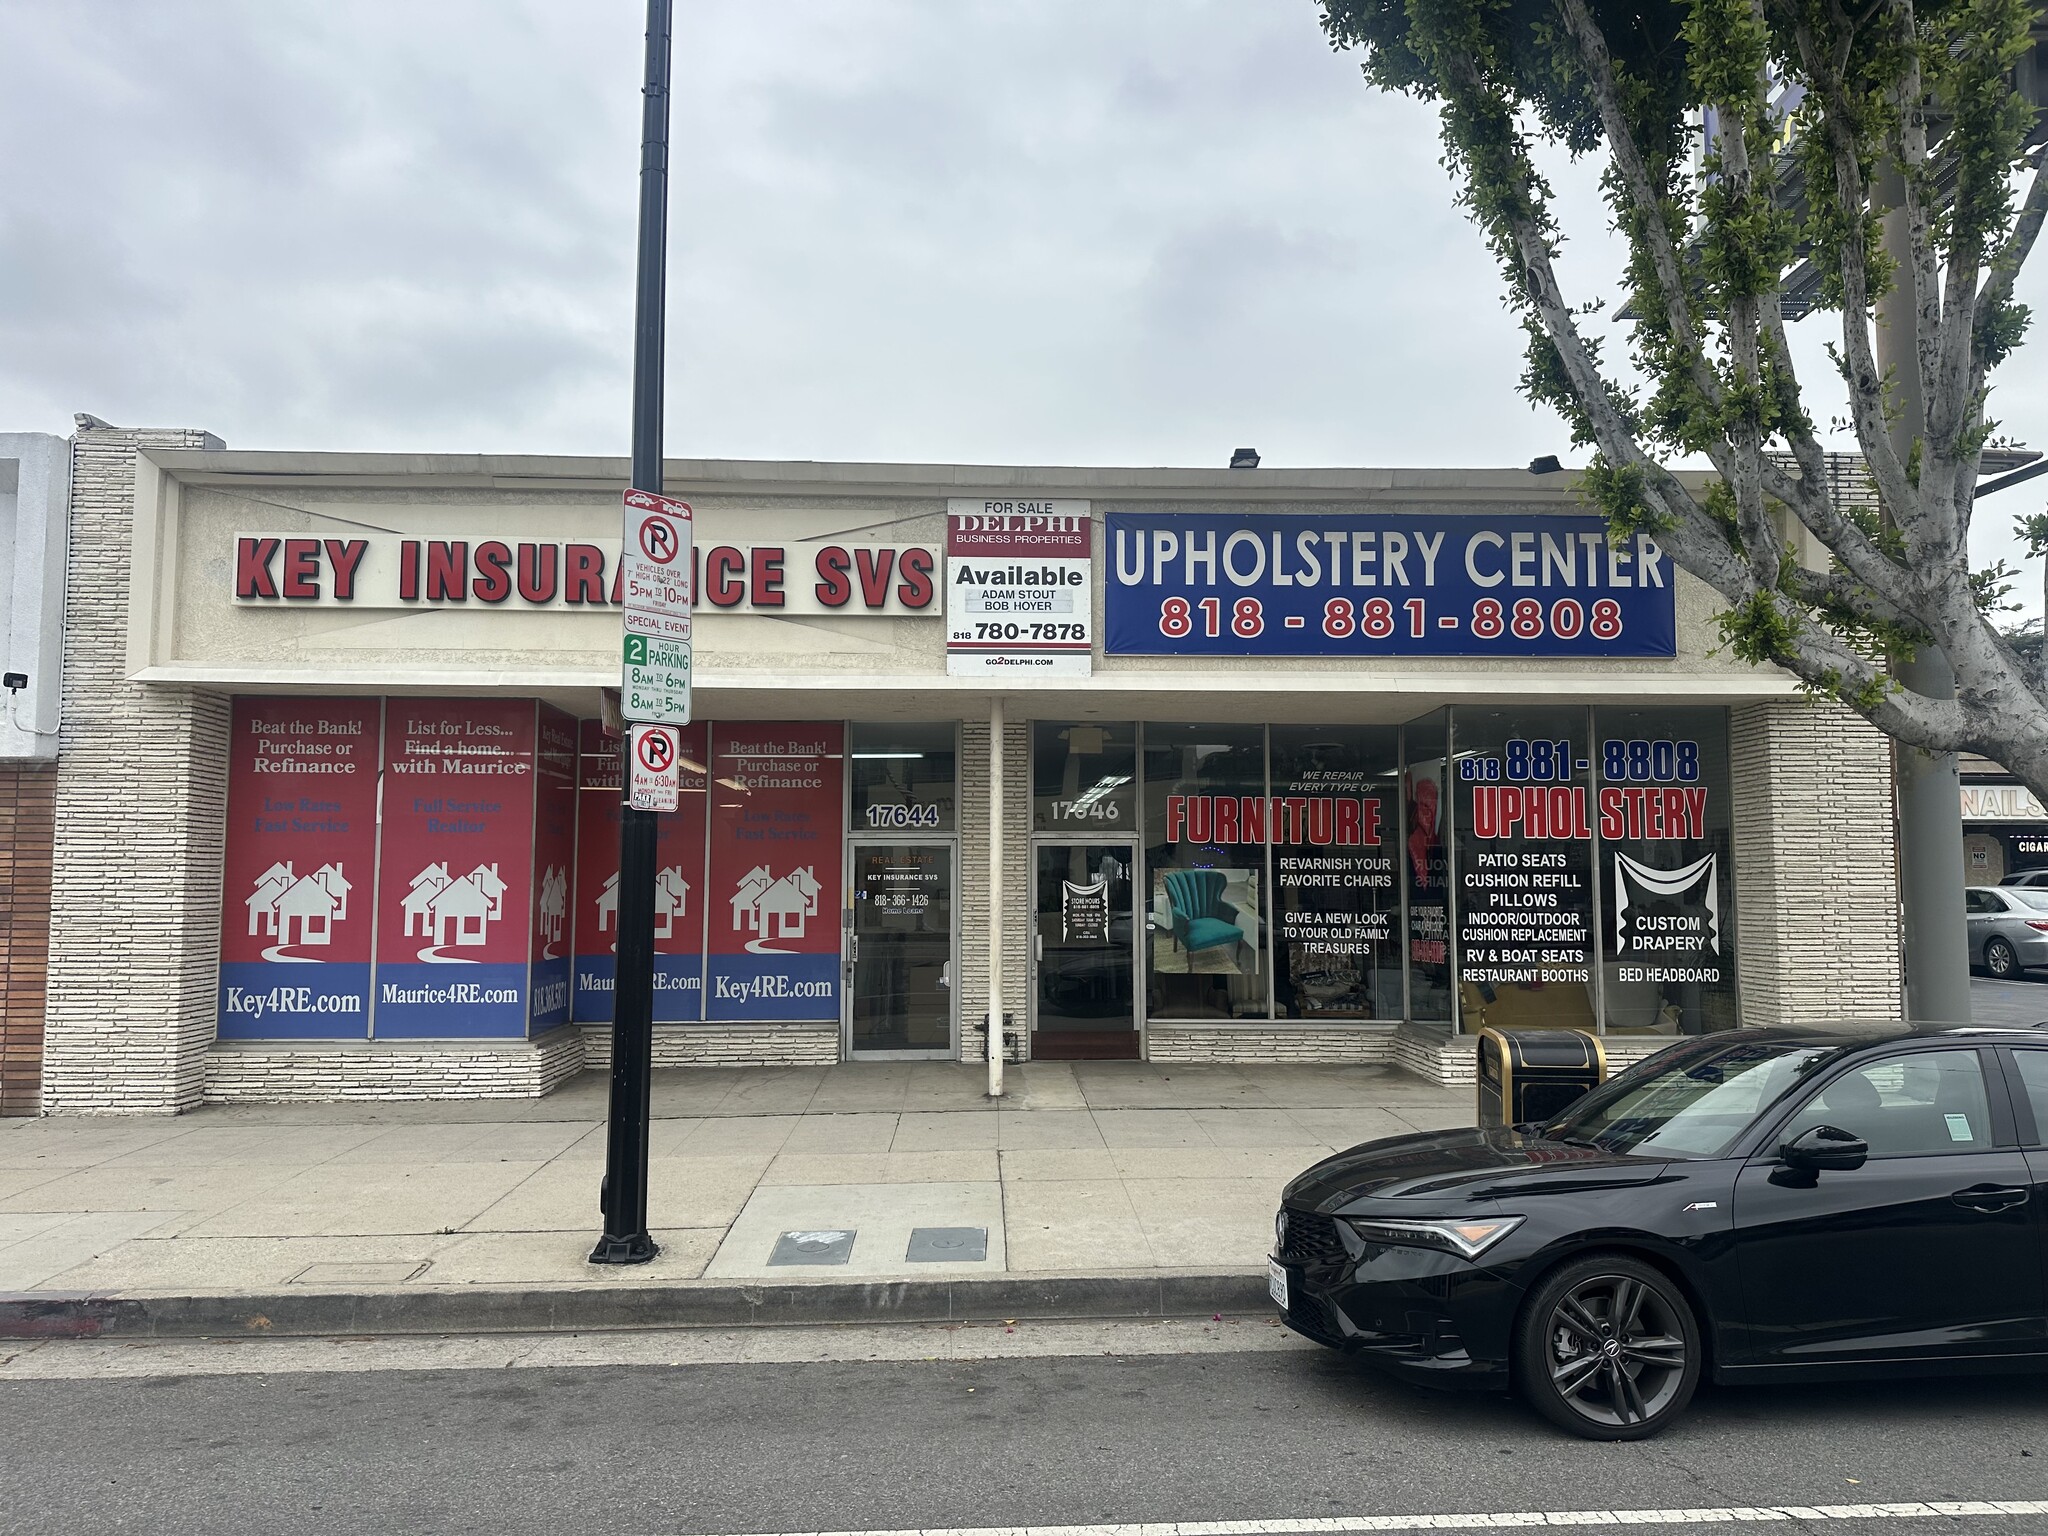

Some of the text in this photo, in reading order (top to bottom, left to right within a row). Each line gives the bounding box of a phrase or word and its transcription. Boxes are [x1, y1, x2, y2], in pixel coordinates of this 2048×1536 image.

[984, 502, 1053, 514] FOR SALE
[957, 515, 1081, 532] DELPHI
[956, 534, 1082, 545] BUSINESS PROPERTIES
[1115, 529, 1664, 588] UPHOLSTERY CENTER
[237, 537, 938, 611] KEY INSURCE SVS
[636, 562, 681, 579] VEHICLES OVER
[955, 565, 1083, 586] Available
[635, 571, 650, 581] HIGH
[674, 579, 689, 589] LONG
[630, 580, 689, 606] 5PM TO 10PM
[981, 590, 1056, 599] ADAM STOUT
[984, 601, 1052, 611] BOB HOYER
[627, 615, 689, 634] SPECIAL EVENT
[1159, 596, 1265, 639] 818
[953, 622, 1085, 640] 818 780-7878
[629, 639, 642, 660] 2
[658, 642, 680, 653] HOUR
[648, 649, 689, 671] PARKING
[985, 656, 1054, 666] GO2DELPHI.COM
[631, 667, 686, 689] 8AM TO 6PM
[631, 692, 685, 714] 8AM TO 5PM
[250, 719, 362, 736] Beat the Bank!
[407, 719, 513, 736] List for Less...
[257, 740, 353, 755] Purchase or
[404, 740, 441, 755] Find
[730, 741, 827, 755] Beat the Bank!
[252, 758, 356, 774] Refinance
[392, 758, 526, 775] with Maurice
[597, 758, 622, 771] Fin
[737, 759, 819, 773] Purchase or
[1602, 740, 1699, 782] 8808
[1302, 770, 1364, 781] WE REPAIR
[1460, 758, 1500, 781] 818
[635, 773, 648, 785] 4AM
[654, 775, 676, 787] 6:30AM
[734, 774, 822, 788] Refinance
[1288, 782, 1377, 792] EVERY TYPE OF
[263, 798, 341, 813] Low Rates
[413, 799, 502, 814] Full Service
[1051, 801, 1119, 819] 17646
[1960, 789, 2044, 816] NAILS
[866, 804, 940, 827] 17644
[1166, 795, 1382, 846] FURNITURE
[254, 818, 349, 833] Fast Service
[428, 818, 486, 833] Realtor
[871, 856, 934, 864] REAL ESTATE
[1280, 858, 1391, 870] REVARNISH YOUR
[1478, 853, 1567, 867] PATIO SEATS
[1280, 875, 1392, 887] FAVORITE CHAIRS
[1464, 873, 1530, 887] CUSHION
[1533, 873, 1581, 887] REFILL
[1489, 893, 1558, 907] PILLOWS
[1285, 912, 1388, 925] GIVE A NEW LOOK
[1468, 912, 1580, 926] INDOOR/OUTDOOR
[1635, 916, 1701, 931] CUSTOM
[1283, 927, 1389, 941] TO YOUR OLD FAMILY
[1462, 928, 1509, 941] CUSHION
[1511, 928, 1587, 942] REPLACEMENT
[1303, 943, 1370, 955] TREASURES
[1632, 936, 1706, 950] DRAPERY
[1466, 949, 1486, 963] RV
[1488, 949, 1498, 963] &
[1501, 949, 1538, 963] BOAT
[1541, 949, 1584, 963] SEATS
[1463, 968, 1589, 983] RESTAURANT BOOTHS
[1619, 968, 1720, 982] BED HEADBOARD
[381, 983, 519, 1004] Maurice4RE.com
[714, 975, 833, 1003] Key4RE.com
[225, 987, 361, 1018] Key4RE.com
